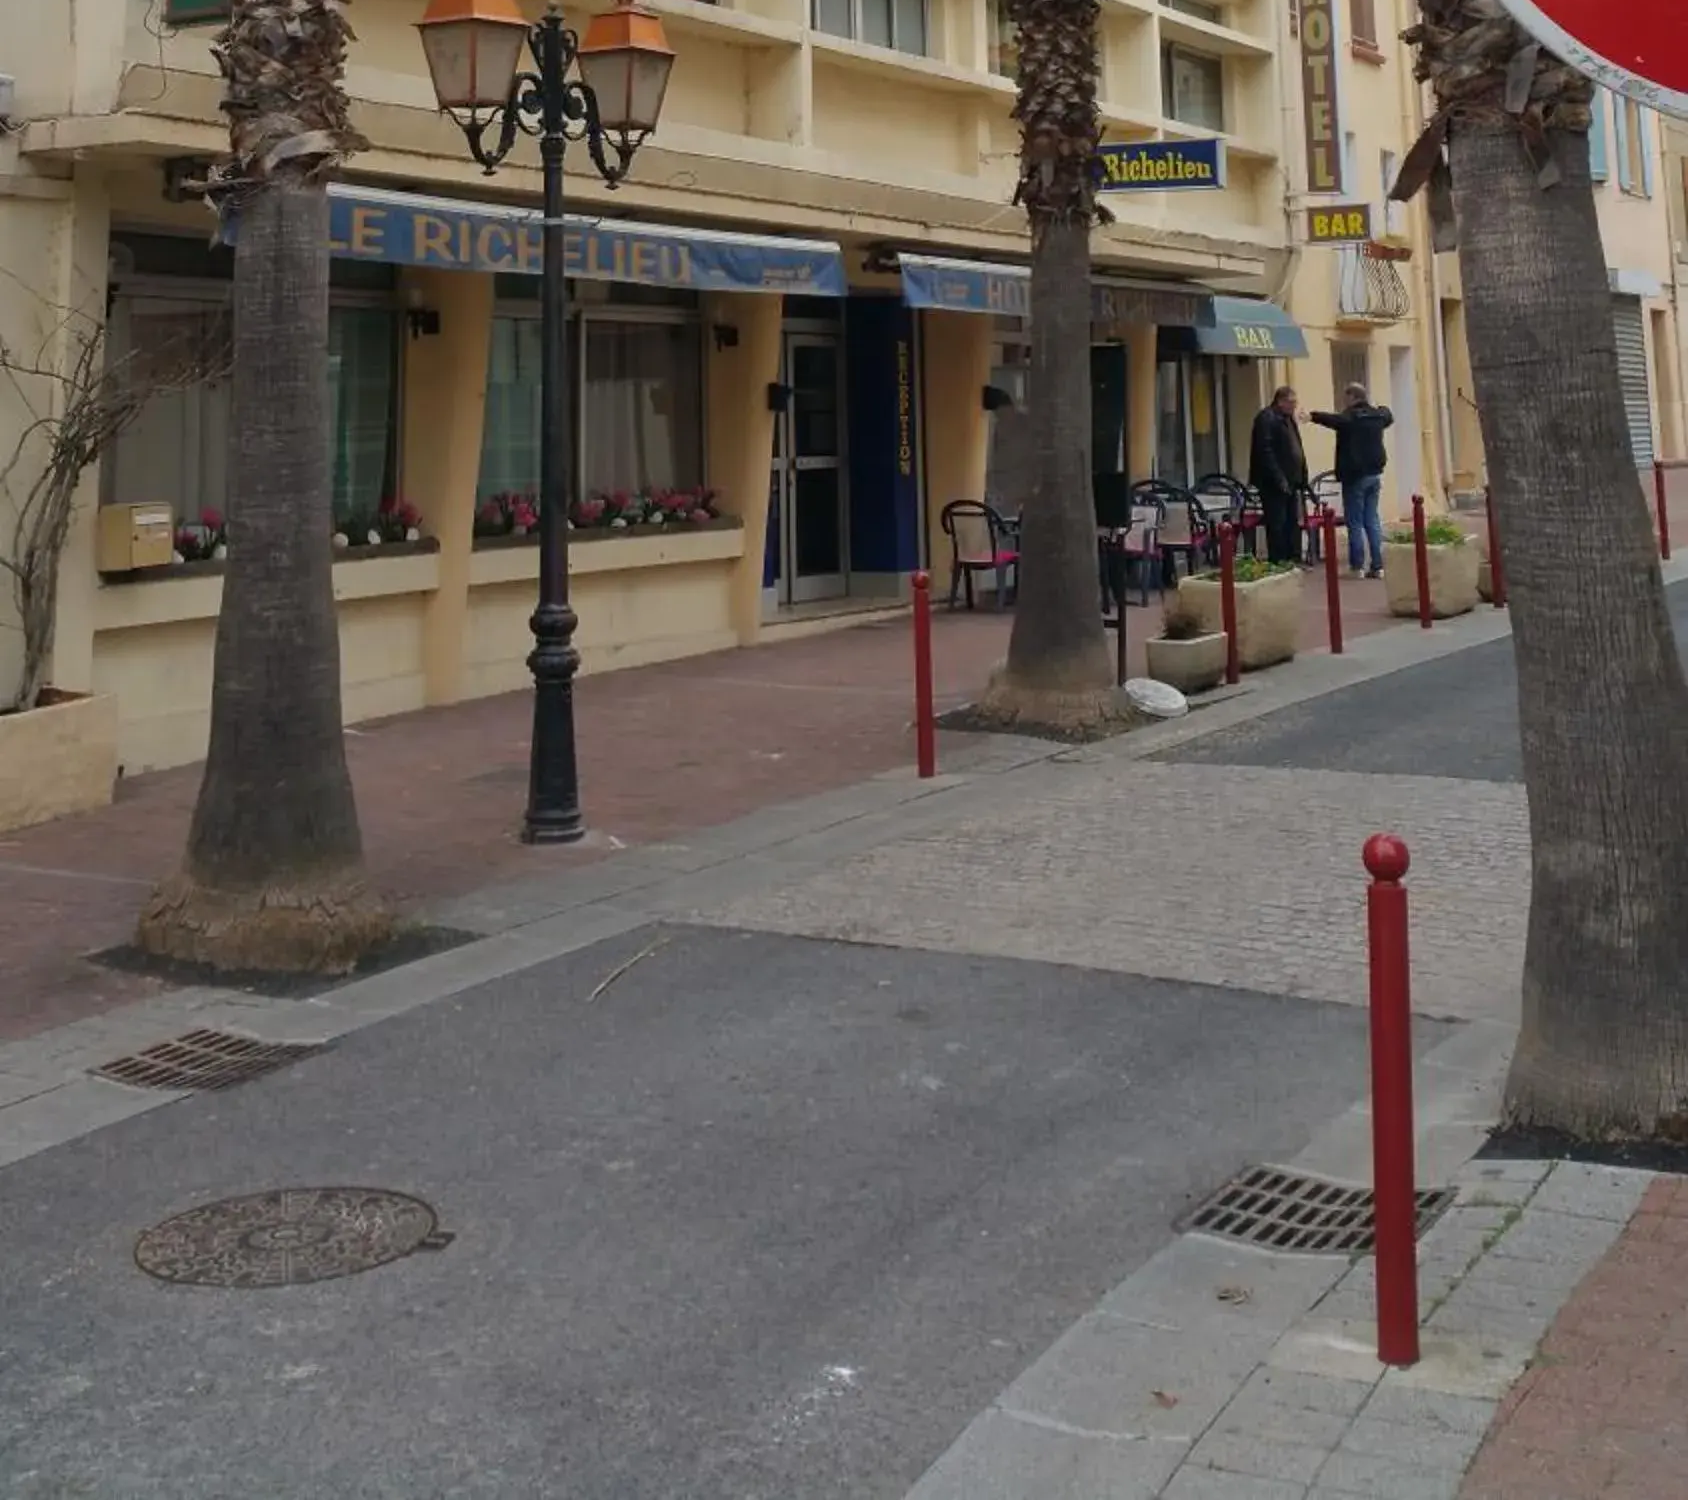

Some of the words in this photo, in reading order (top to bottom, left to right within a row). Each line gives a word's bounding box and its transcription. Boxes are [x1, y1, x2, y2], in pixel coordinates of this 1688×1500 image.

[1101, 151, 1213, 183] Richelieu
[1312, 211, 1364, 237] BAR
[325, 206, 387, 255] E
[413, 213, 691, 285] RICHELIEU
[1232, 325, 1275, 349] BAR
